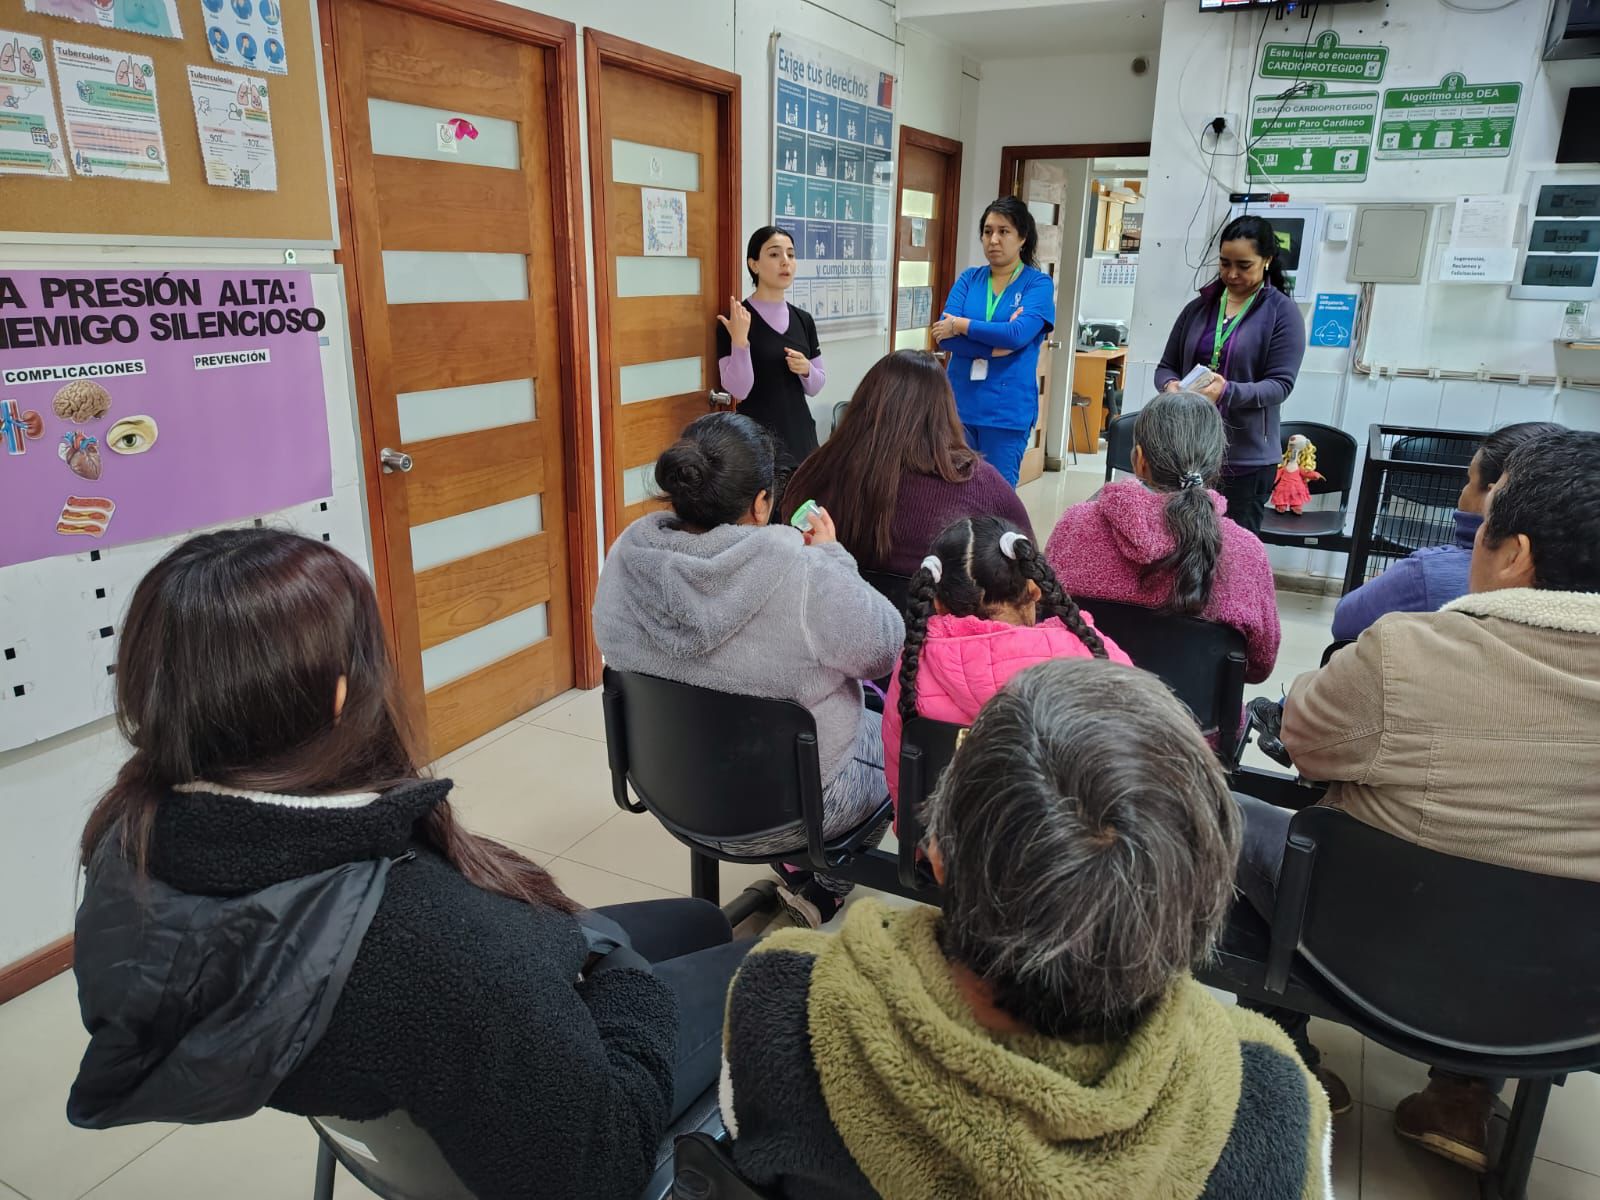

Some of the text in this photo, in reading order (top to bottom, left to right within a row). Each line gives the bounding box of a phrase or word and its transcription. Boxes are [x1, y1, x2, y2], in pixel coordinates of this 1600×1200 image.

[56, 47, 110, 62] Tuberculosis
[1270, 48, 1379, 61] Este lugar se encuentra
[779, 48, 868, 98] Exige tus derechos
[1267, 61, 1364, 74] CARDIOPROTEGIDO
[190, 71, 233, 85] Tuberculosis
[1402, 91, 1451, 103] Algoritmo
[1455, 91, 1473, 99] uso
[1476, 89, 1500, 99] DEA
[1257, 105, 1291, 114] ESPACIO
[1293, 103, 1373, 113] CARDIOPROTEGIDO
[1261, 120, 1282, 129] Ante
[1299, 120, 1320, 128] Paro
[823, 261, 848, 277] cumple
[850, 262, 860, 274] tus
[40, 272, 203, 309] PRESIÓN
[219, 278, 297, 307] ALTA:
[150, 307, 326, 342] SILENCIOSO
[195, 351, 266, 368] PREVENCIÓN
[5, 361, 144, 383] COMPLICACIONES
